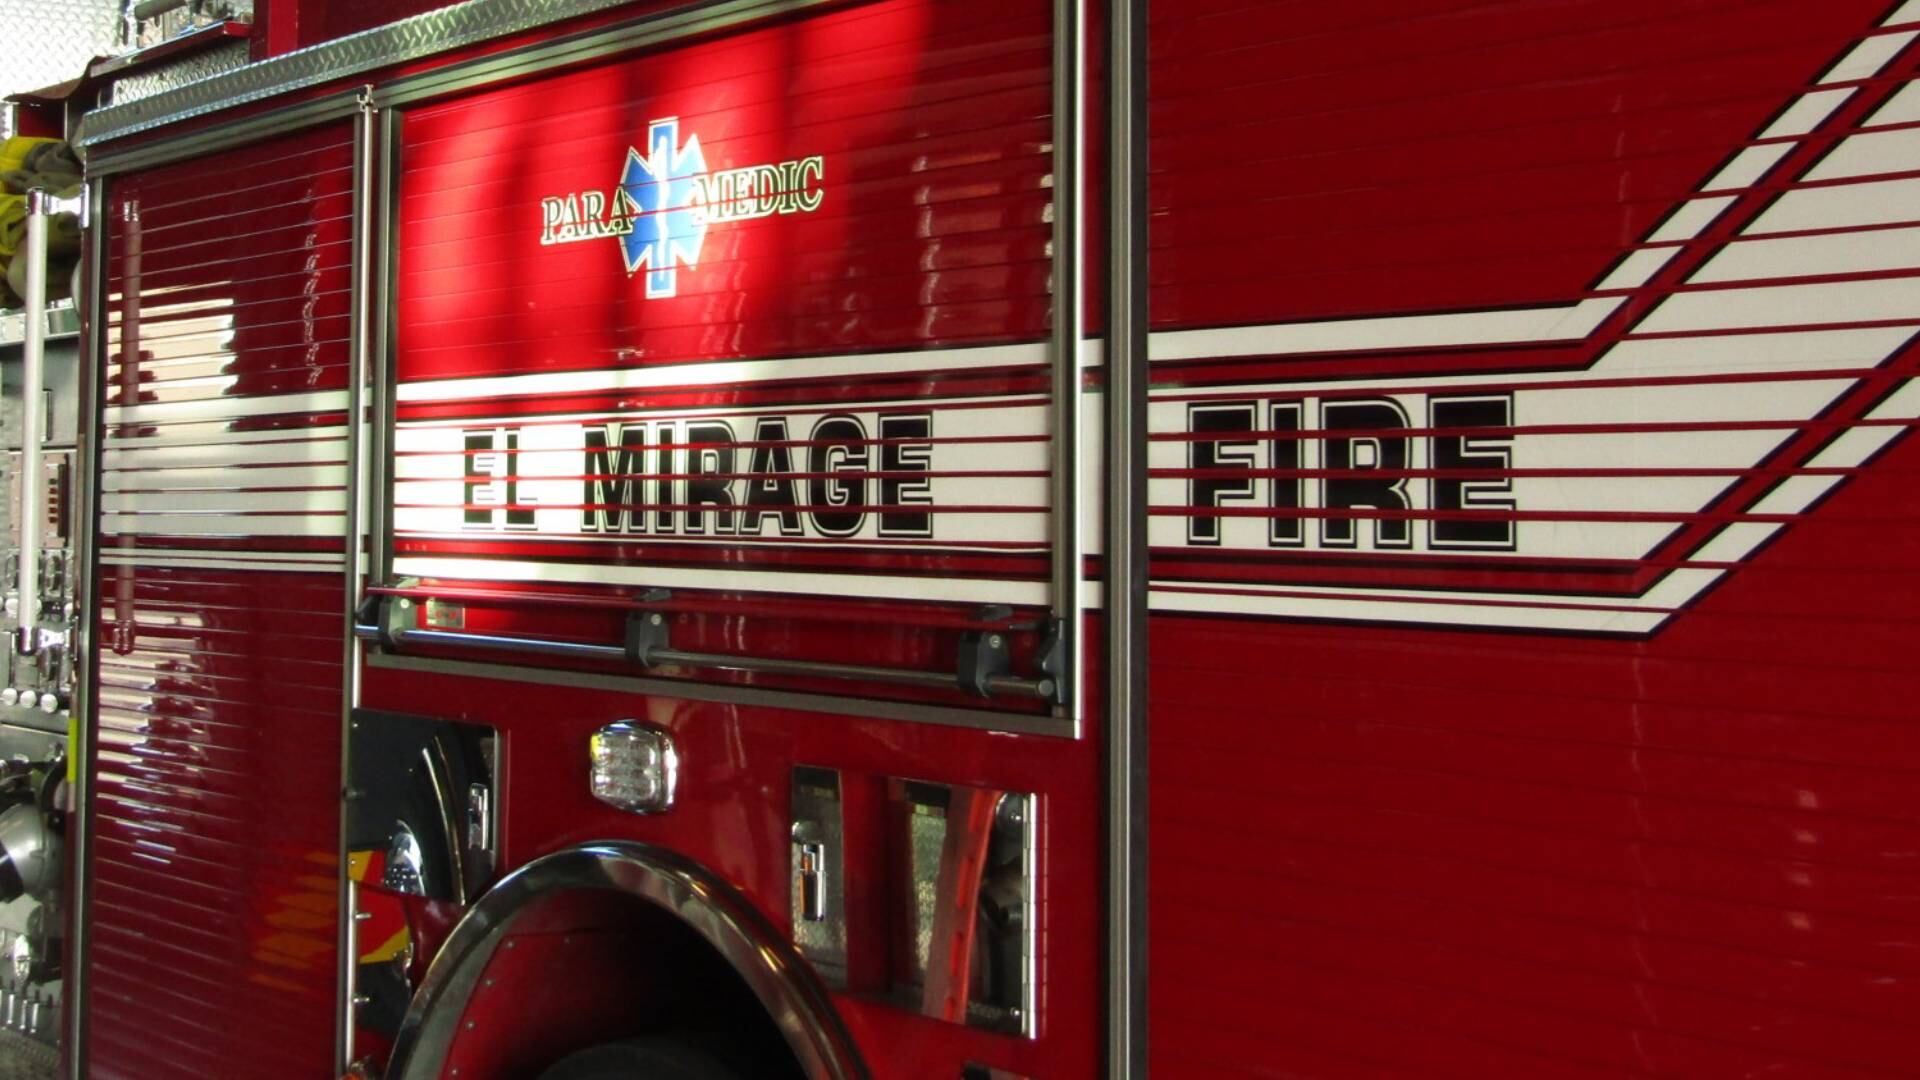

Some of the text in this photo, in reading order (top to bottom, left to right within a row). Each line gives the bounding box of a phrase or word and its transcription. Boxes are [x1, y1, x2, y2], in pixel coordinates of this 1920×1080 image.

[540, 156, 824, 245] PARA MEDIC
[461, 390, 1517, 551] EL MIRAGE FIRE
